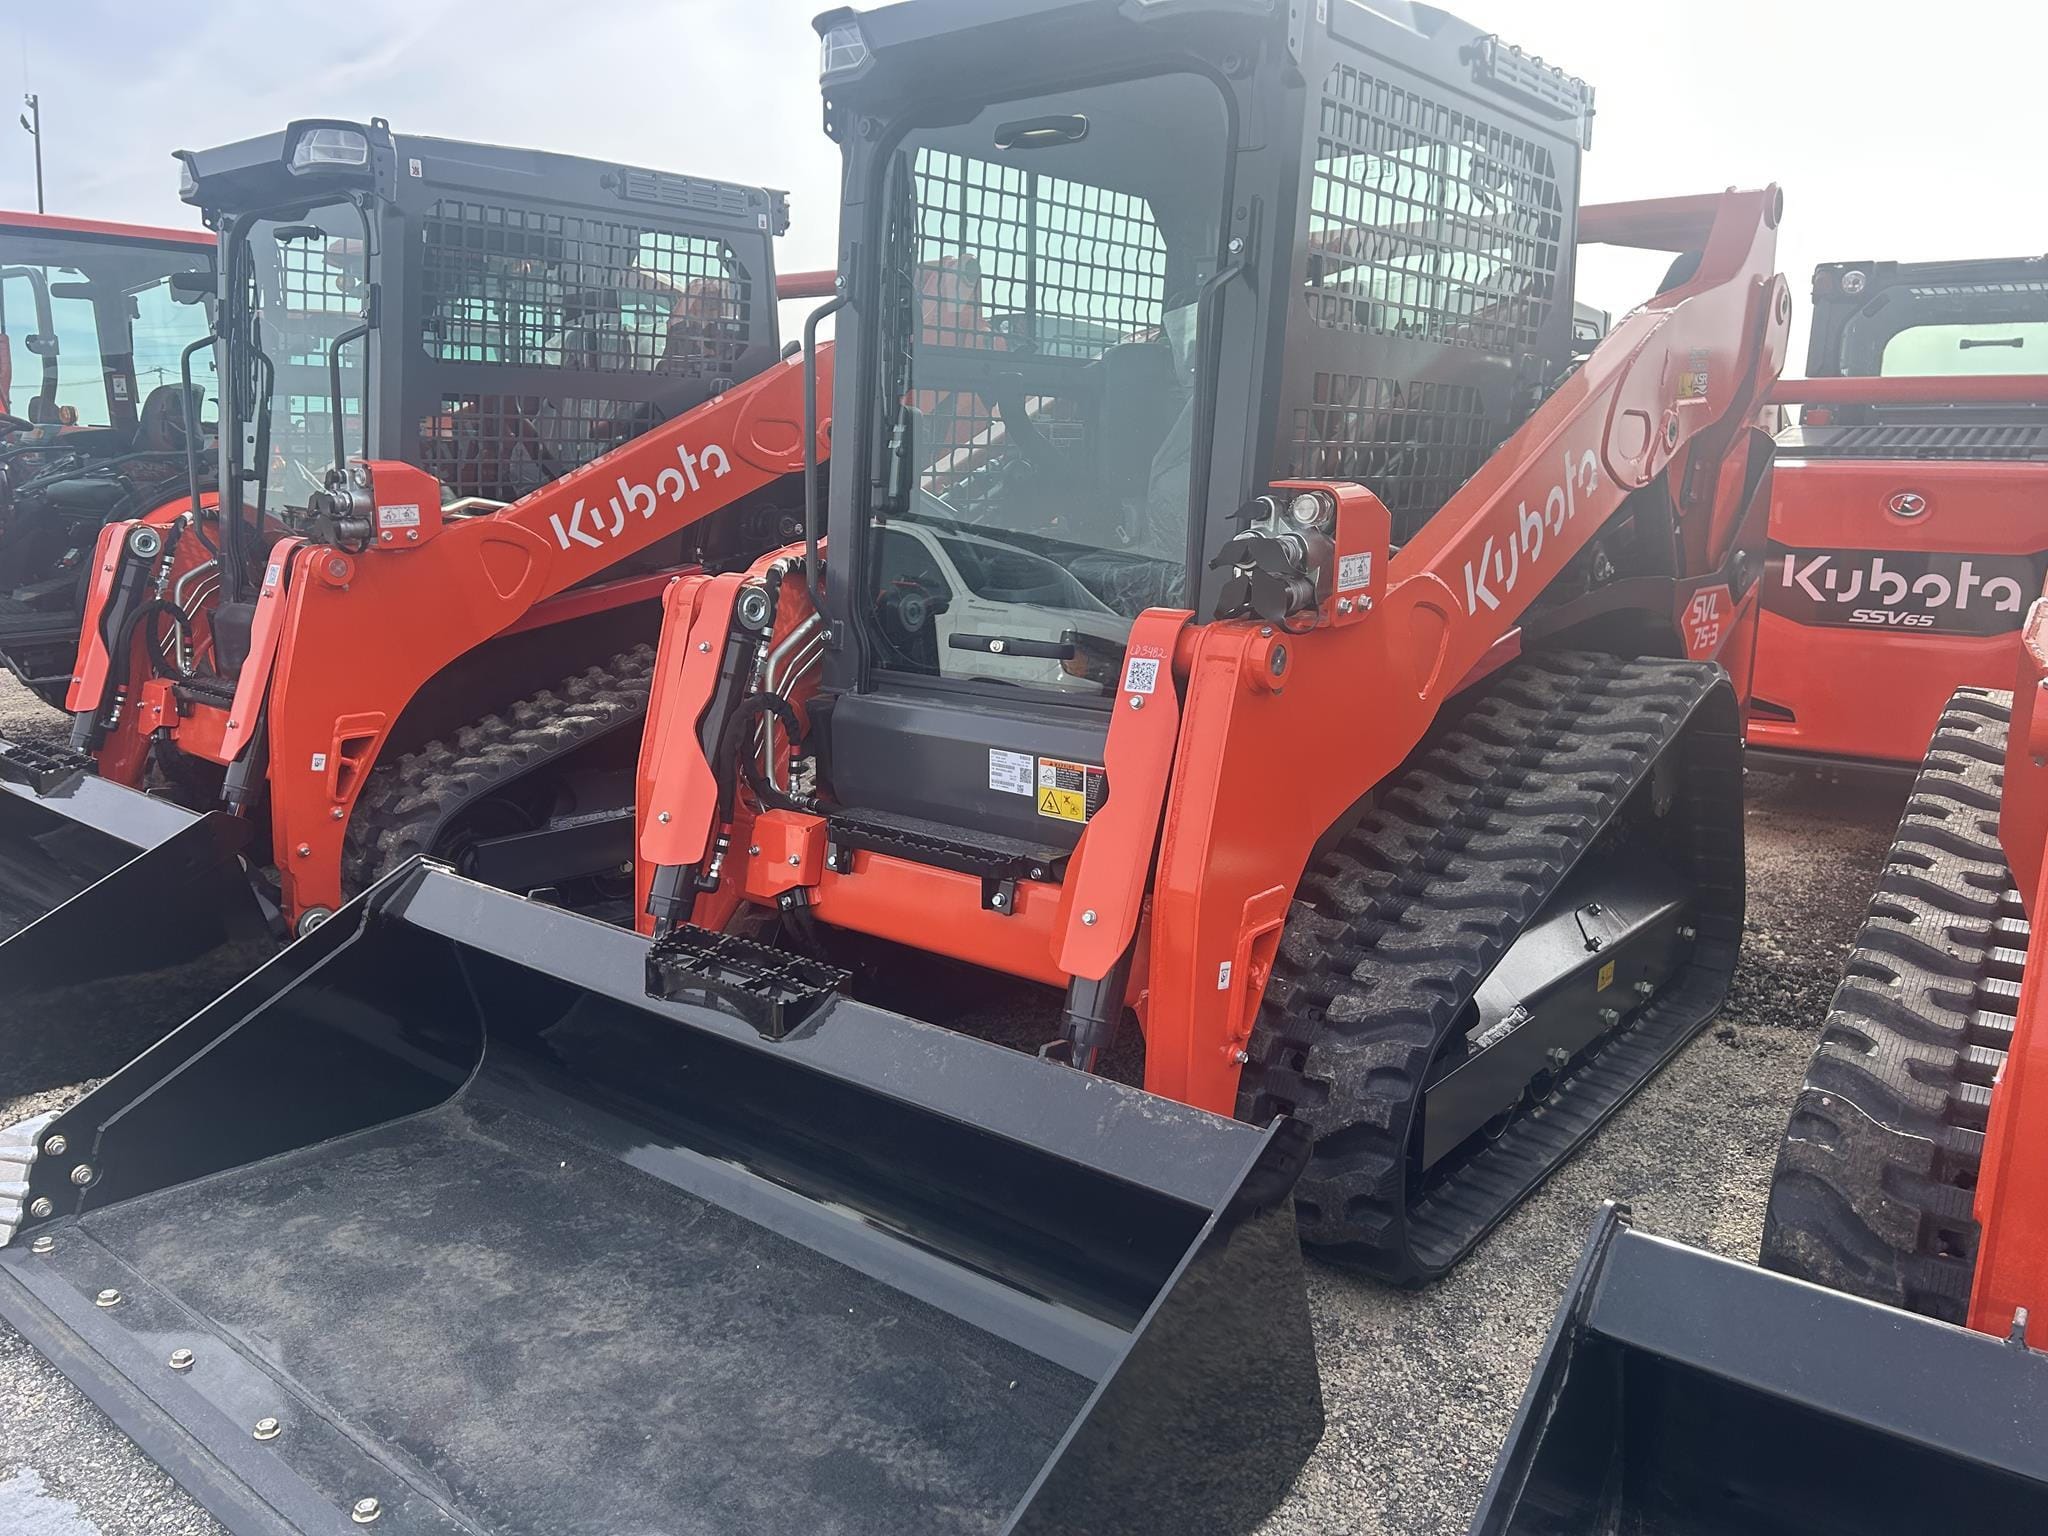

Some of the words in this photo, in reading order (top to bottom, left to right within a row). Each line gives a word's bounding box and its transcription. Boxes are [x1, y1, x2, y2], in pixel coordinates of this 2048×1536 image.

[549, 444, 732, 550] Kubota
[1464, 449, 1598, 616] Kubota
[1690, 593, 1720, 625] SVL
[1782, 554, 2022, 612] Kubota
[1849, 609, 1935, 627] SSV65
